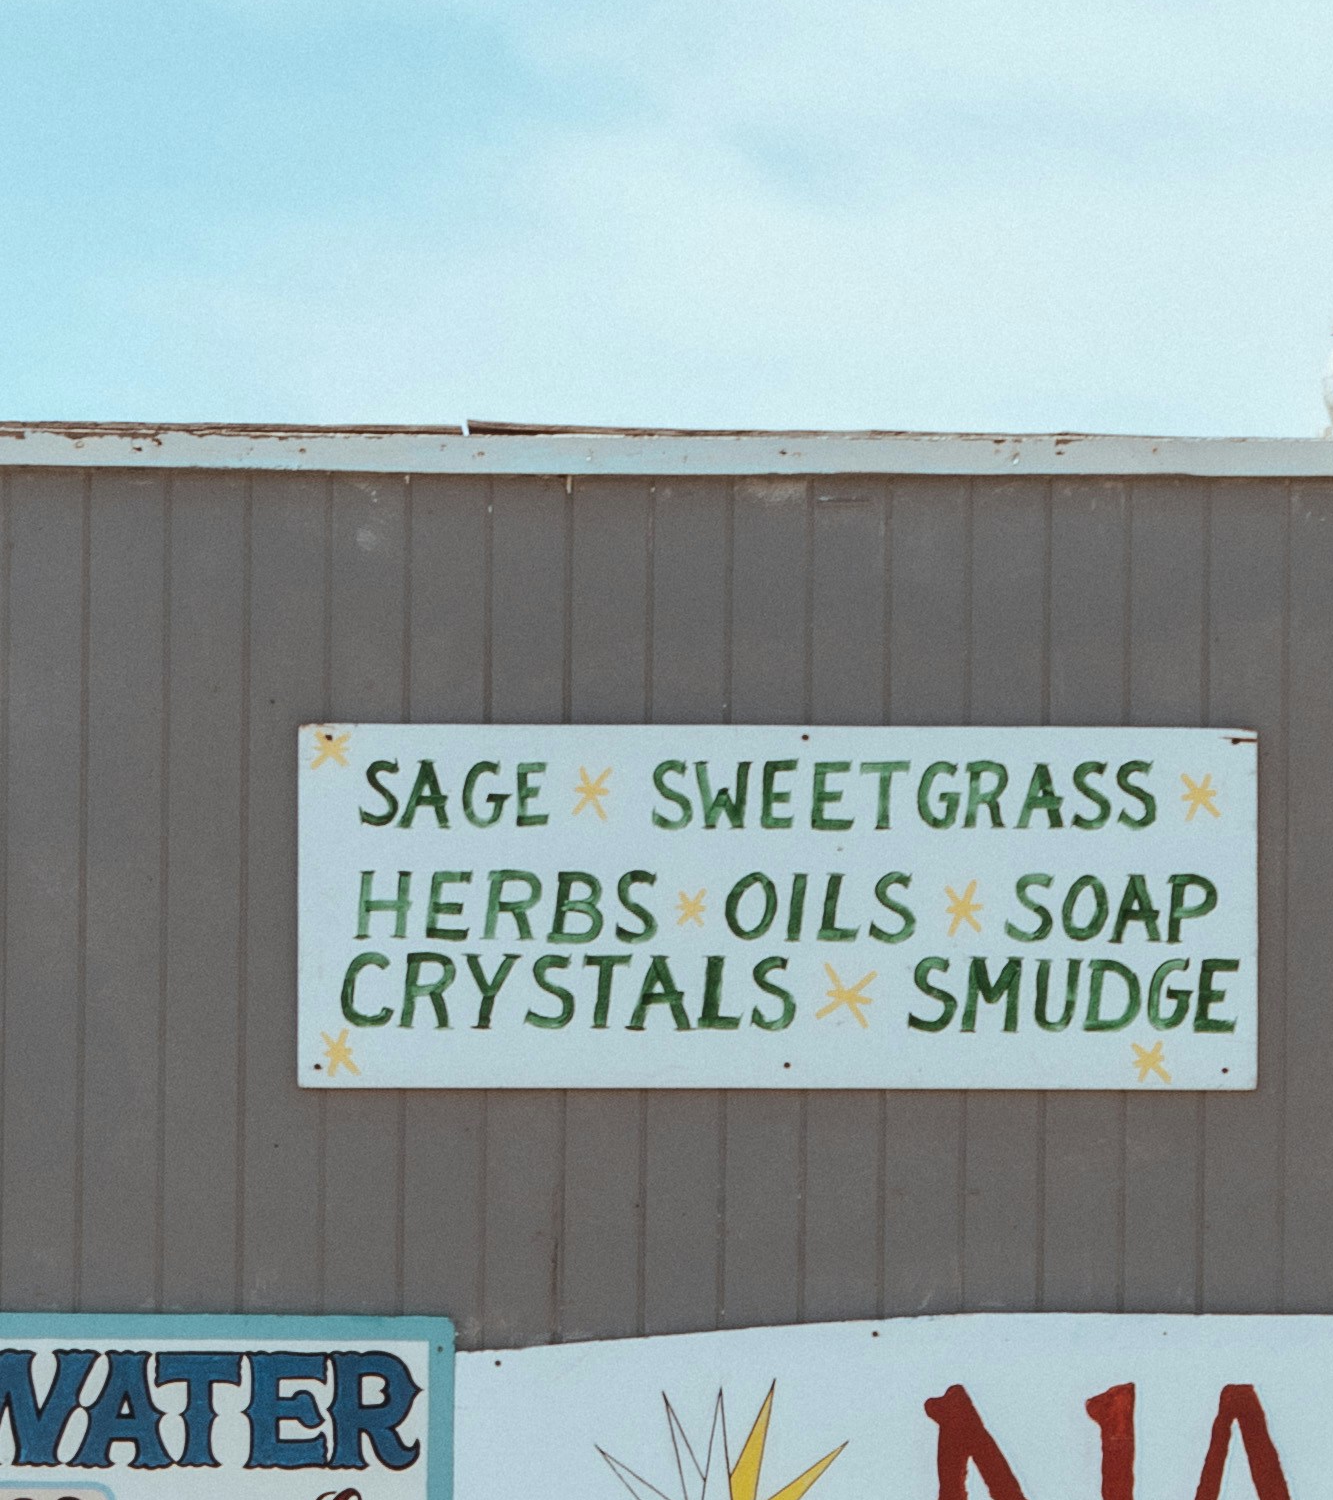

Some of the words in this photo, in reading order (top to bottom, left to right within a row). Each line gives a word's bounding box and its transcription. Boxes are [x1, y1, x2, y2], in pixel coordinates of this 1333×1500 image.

[359, 759, 551, 829] SAGE
[650, 758, 1158, 831] SWEETGRASS
[352, 867, 660, 944] HERBS
[724, 870, 918, 943] OILS
[1003, 872, 1220, 944] SOAP
[339, 951, 798, 1033] CRYSTALS
[907, 955, 1241, 1034] SMUDGE
